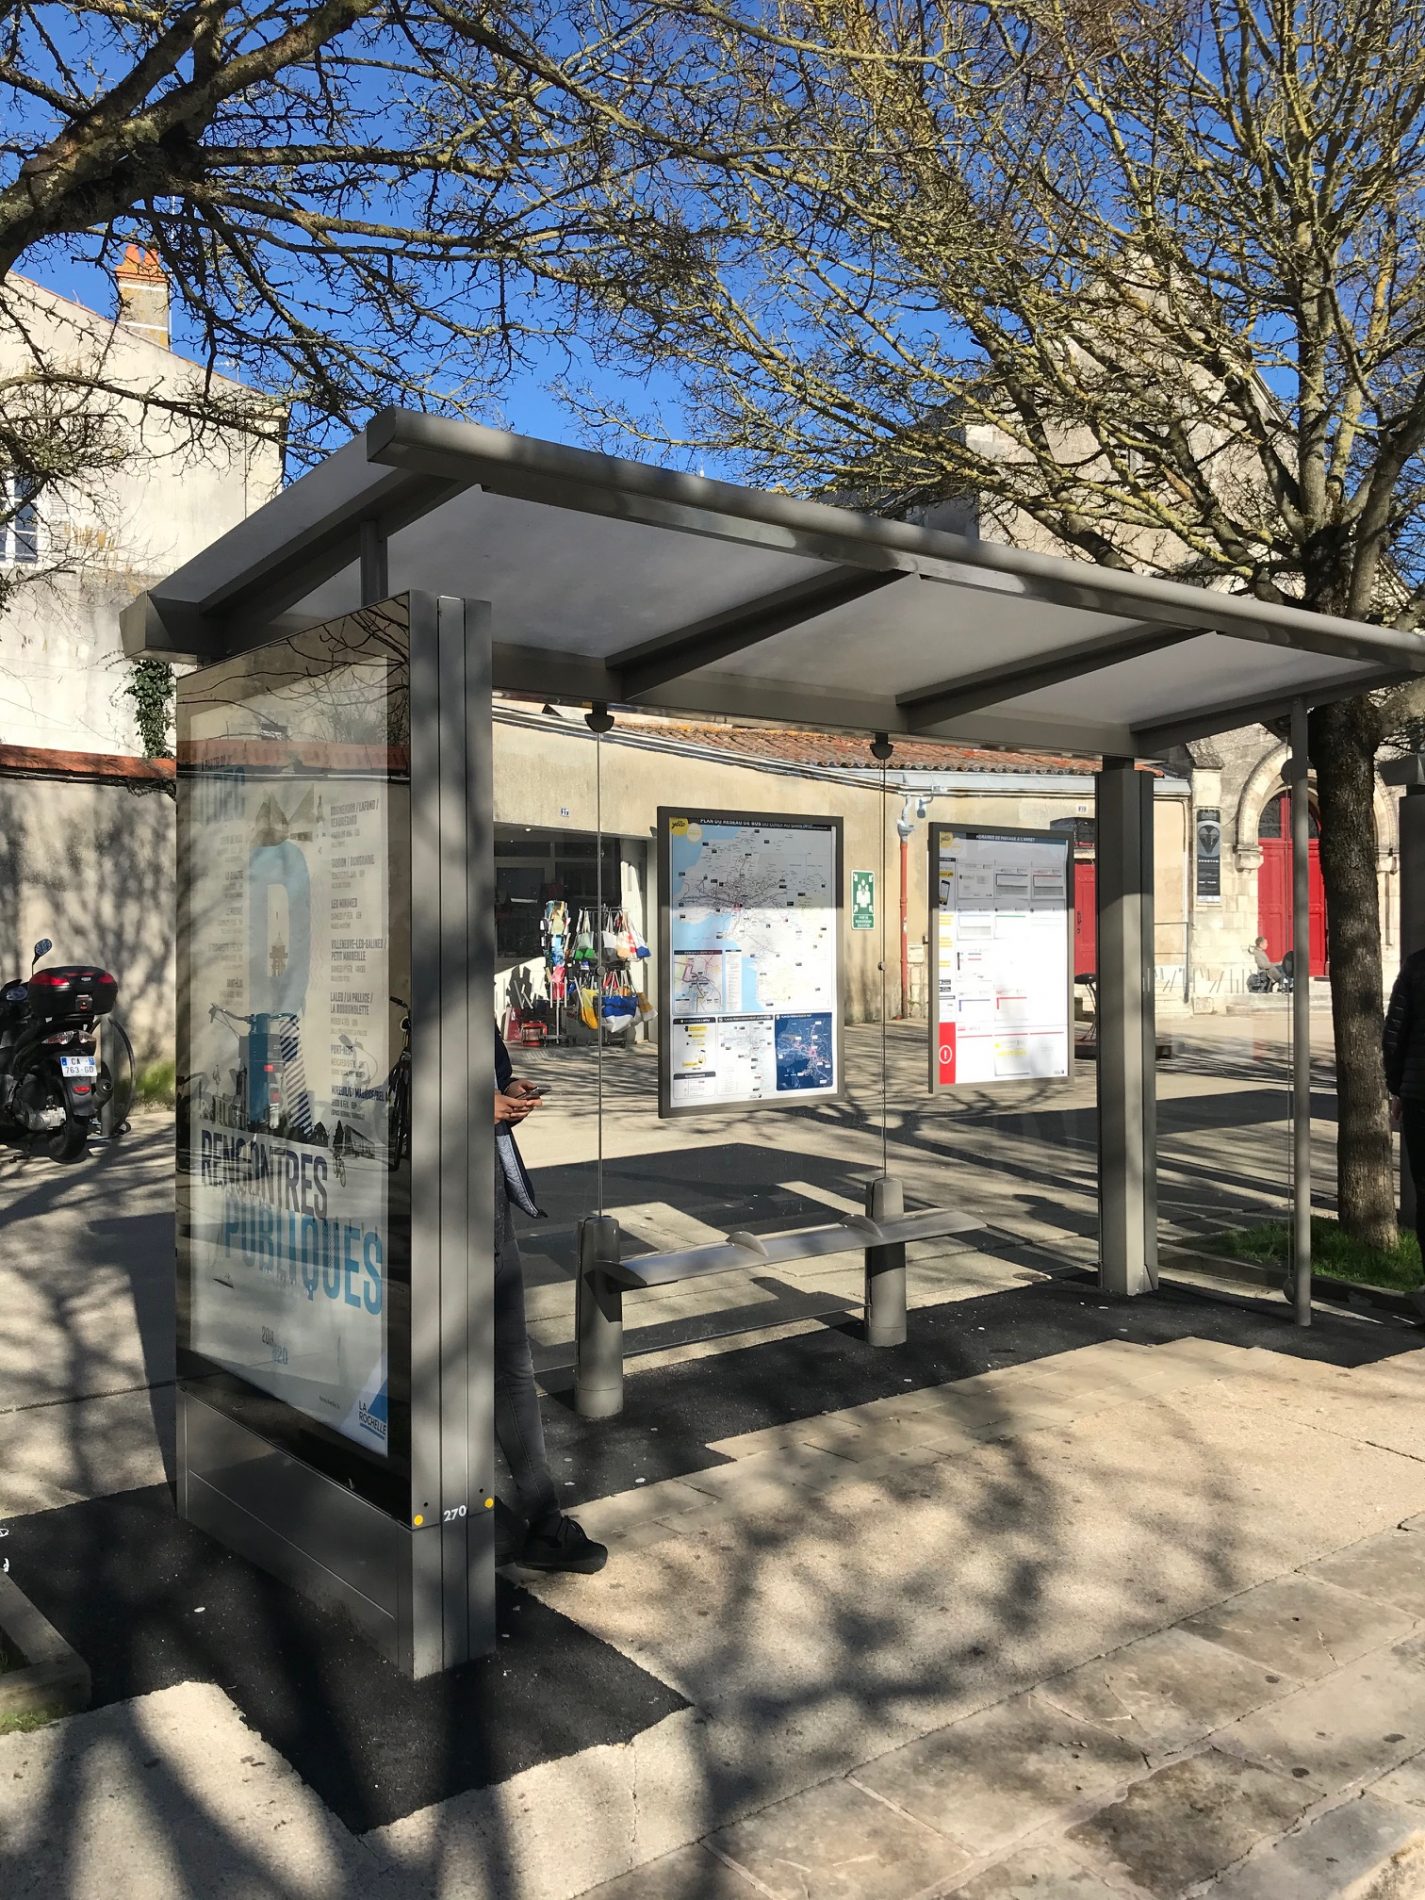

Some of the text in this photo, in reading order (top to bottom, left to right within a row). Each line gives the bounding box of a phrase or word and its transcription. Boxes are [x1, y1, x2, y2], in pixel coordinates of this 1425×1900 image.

[201, 1129, 328, 1221] RENCONTRES
[225, 1198, 382, 1316] PUBLIQUES
[358, 1400, 367, 1412] LA
[358, 1411, 387, 1436] ROCHELLE
[443, 1504, 467, 1522] 270
